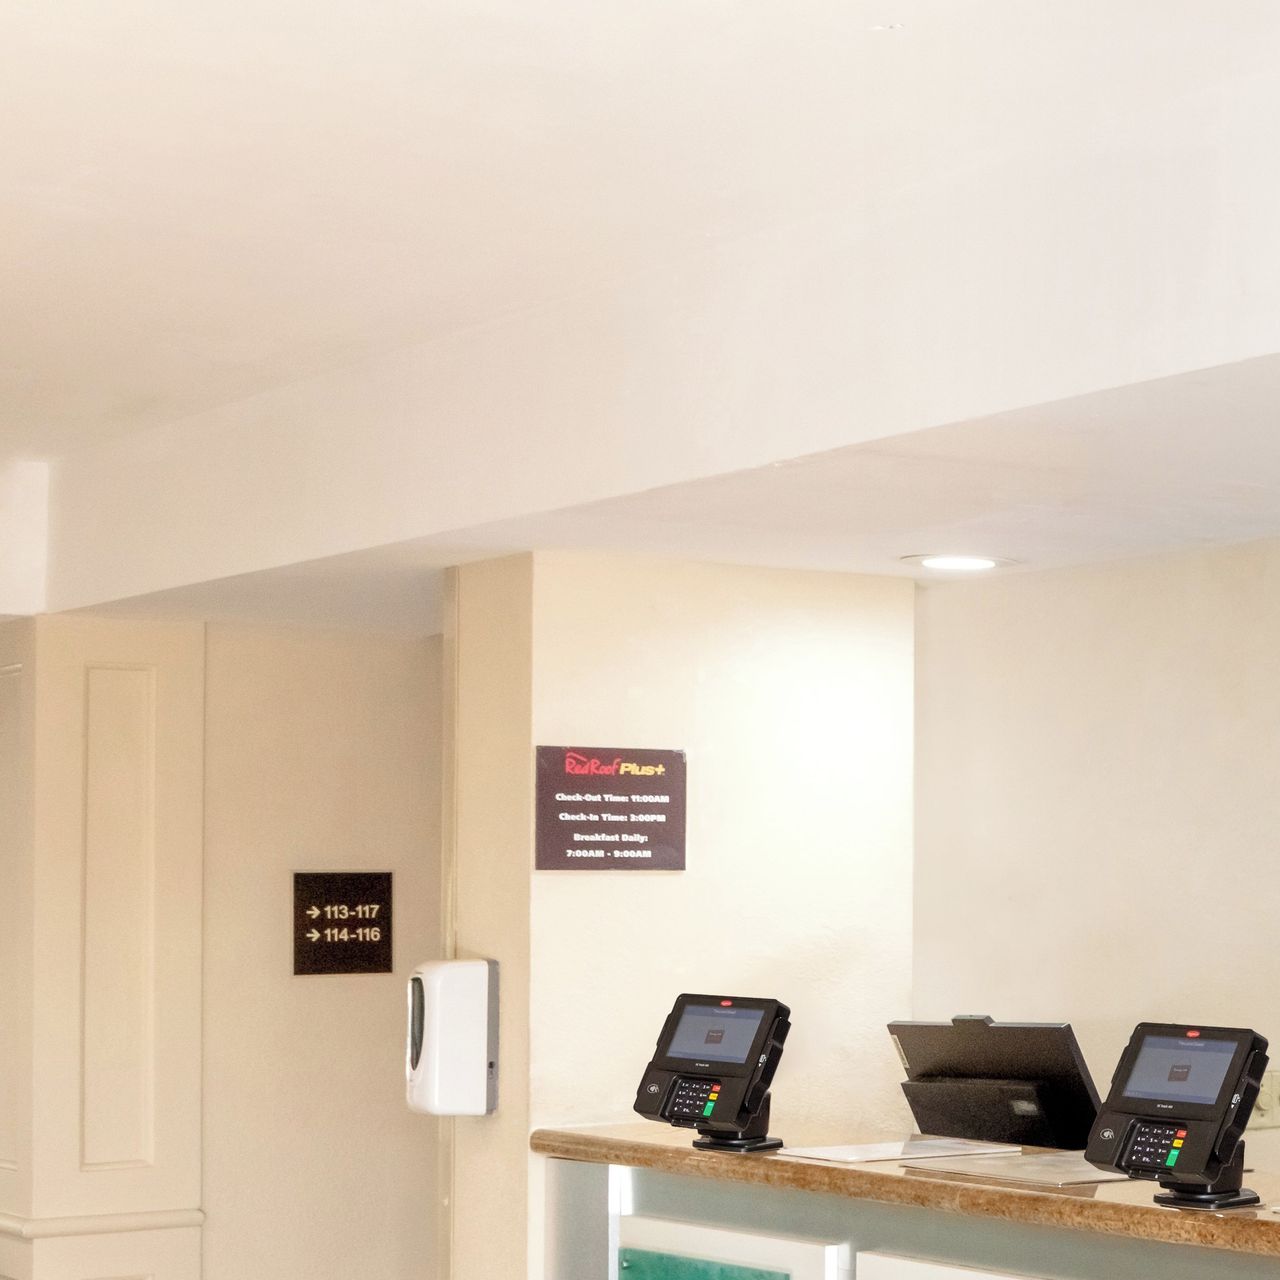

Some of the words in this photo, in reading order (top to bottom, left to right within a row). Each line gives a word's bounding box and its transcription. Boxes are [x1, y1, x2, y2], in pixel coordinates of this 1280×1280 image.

[555, 793, 602, 802] Check-Out
[602, 794, 629, 802] Time:
[631, 795, 670, 803] 11:00AM
[559, 812, 599, 822] Check-In
[601, 813, 628, 822] Time:
[630, 814, 666, 822] 3:00PM
[573, 833, 620, 842] Breakfast
[621, 833, 649, 844] Daily:
[566, 849, 605, 858] 7:00AM
[613, 850, 652, 858] 9:00AM
[324, 904, 380, 919] 113-117
[324, 927, 381, 942] 114-116
